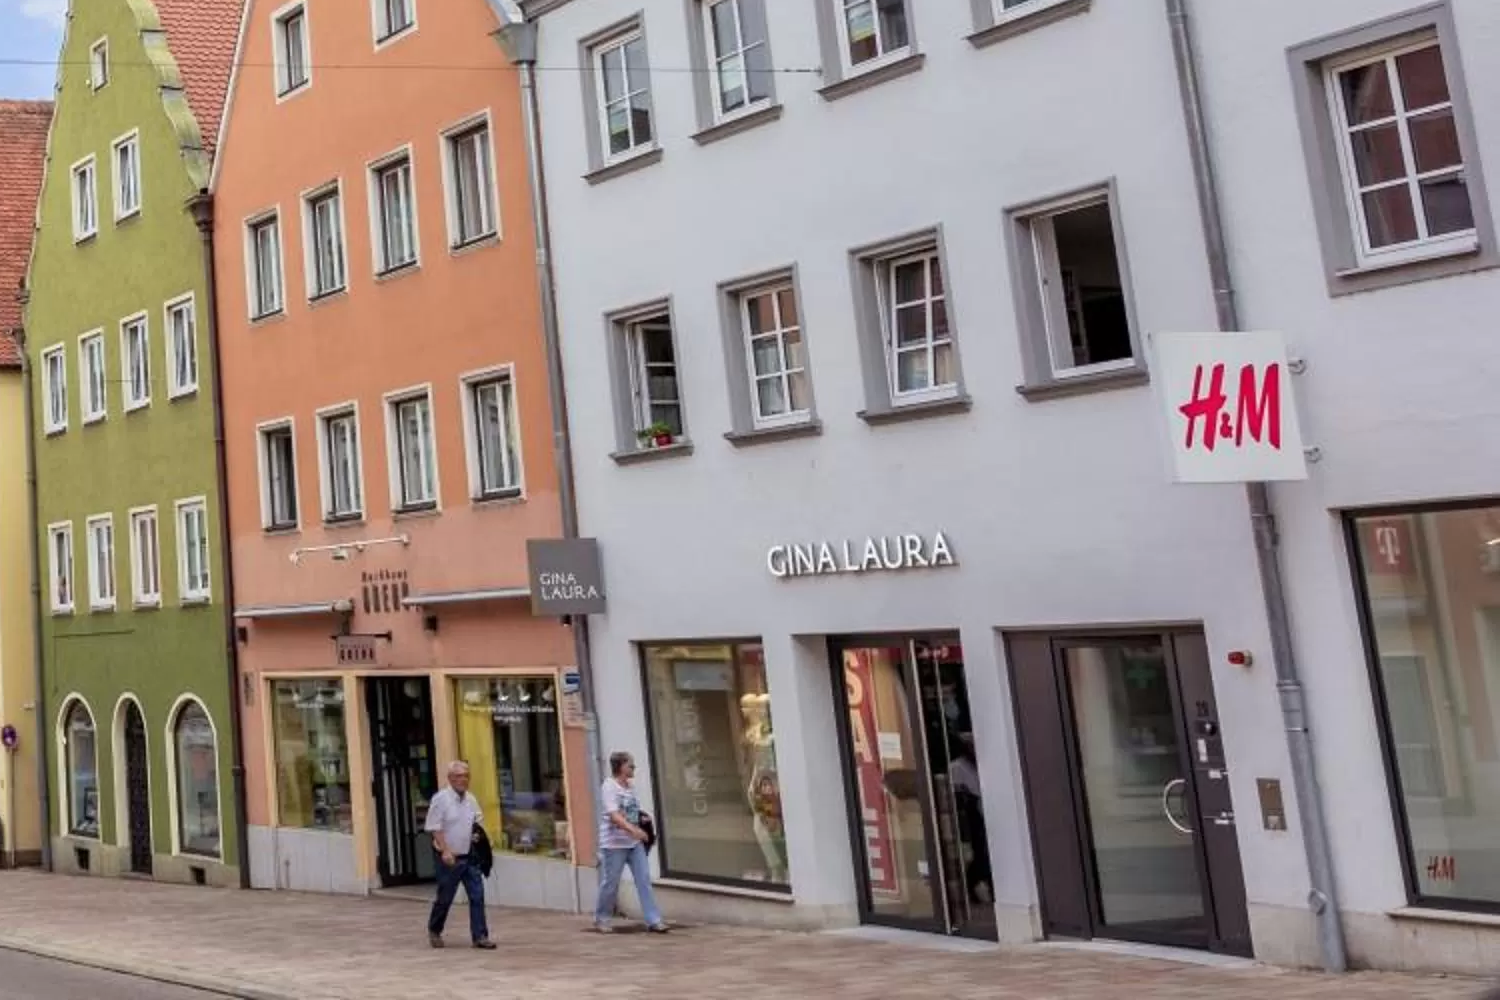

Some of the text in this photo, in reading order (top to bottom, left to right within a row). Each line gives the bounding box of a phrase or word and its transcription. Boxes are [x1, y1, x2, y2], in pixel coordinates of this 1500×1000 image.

[1179, 362, 1280, 452] H&M
[767, 532, 953, 576] GINA LAURA
[540, 572, 577, 585] GINA
[541, 585, 598, 600] LAURA
